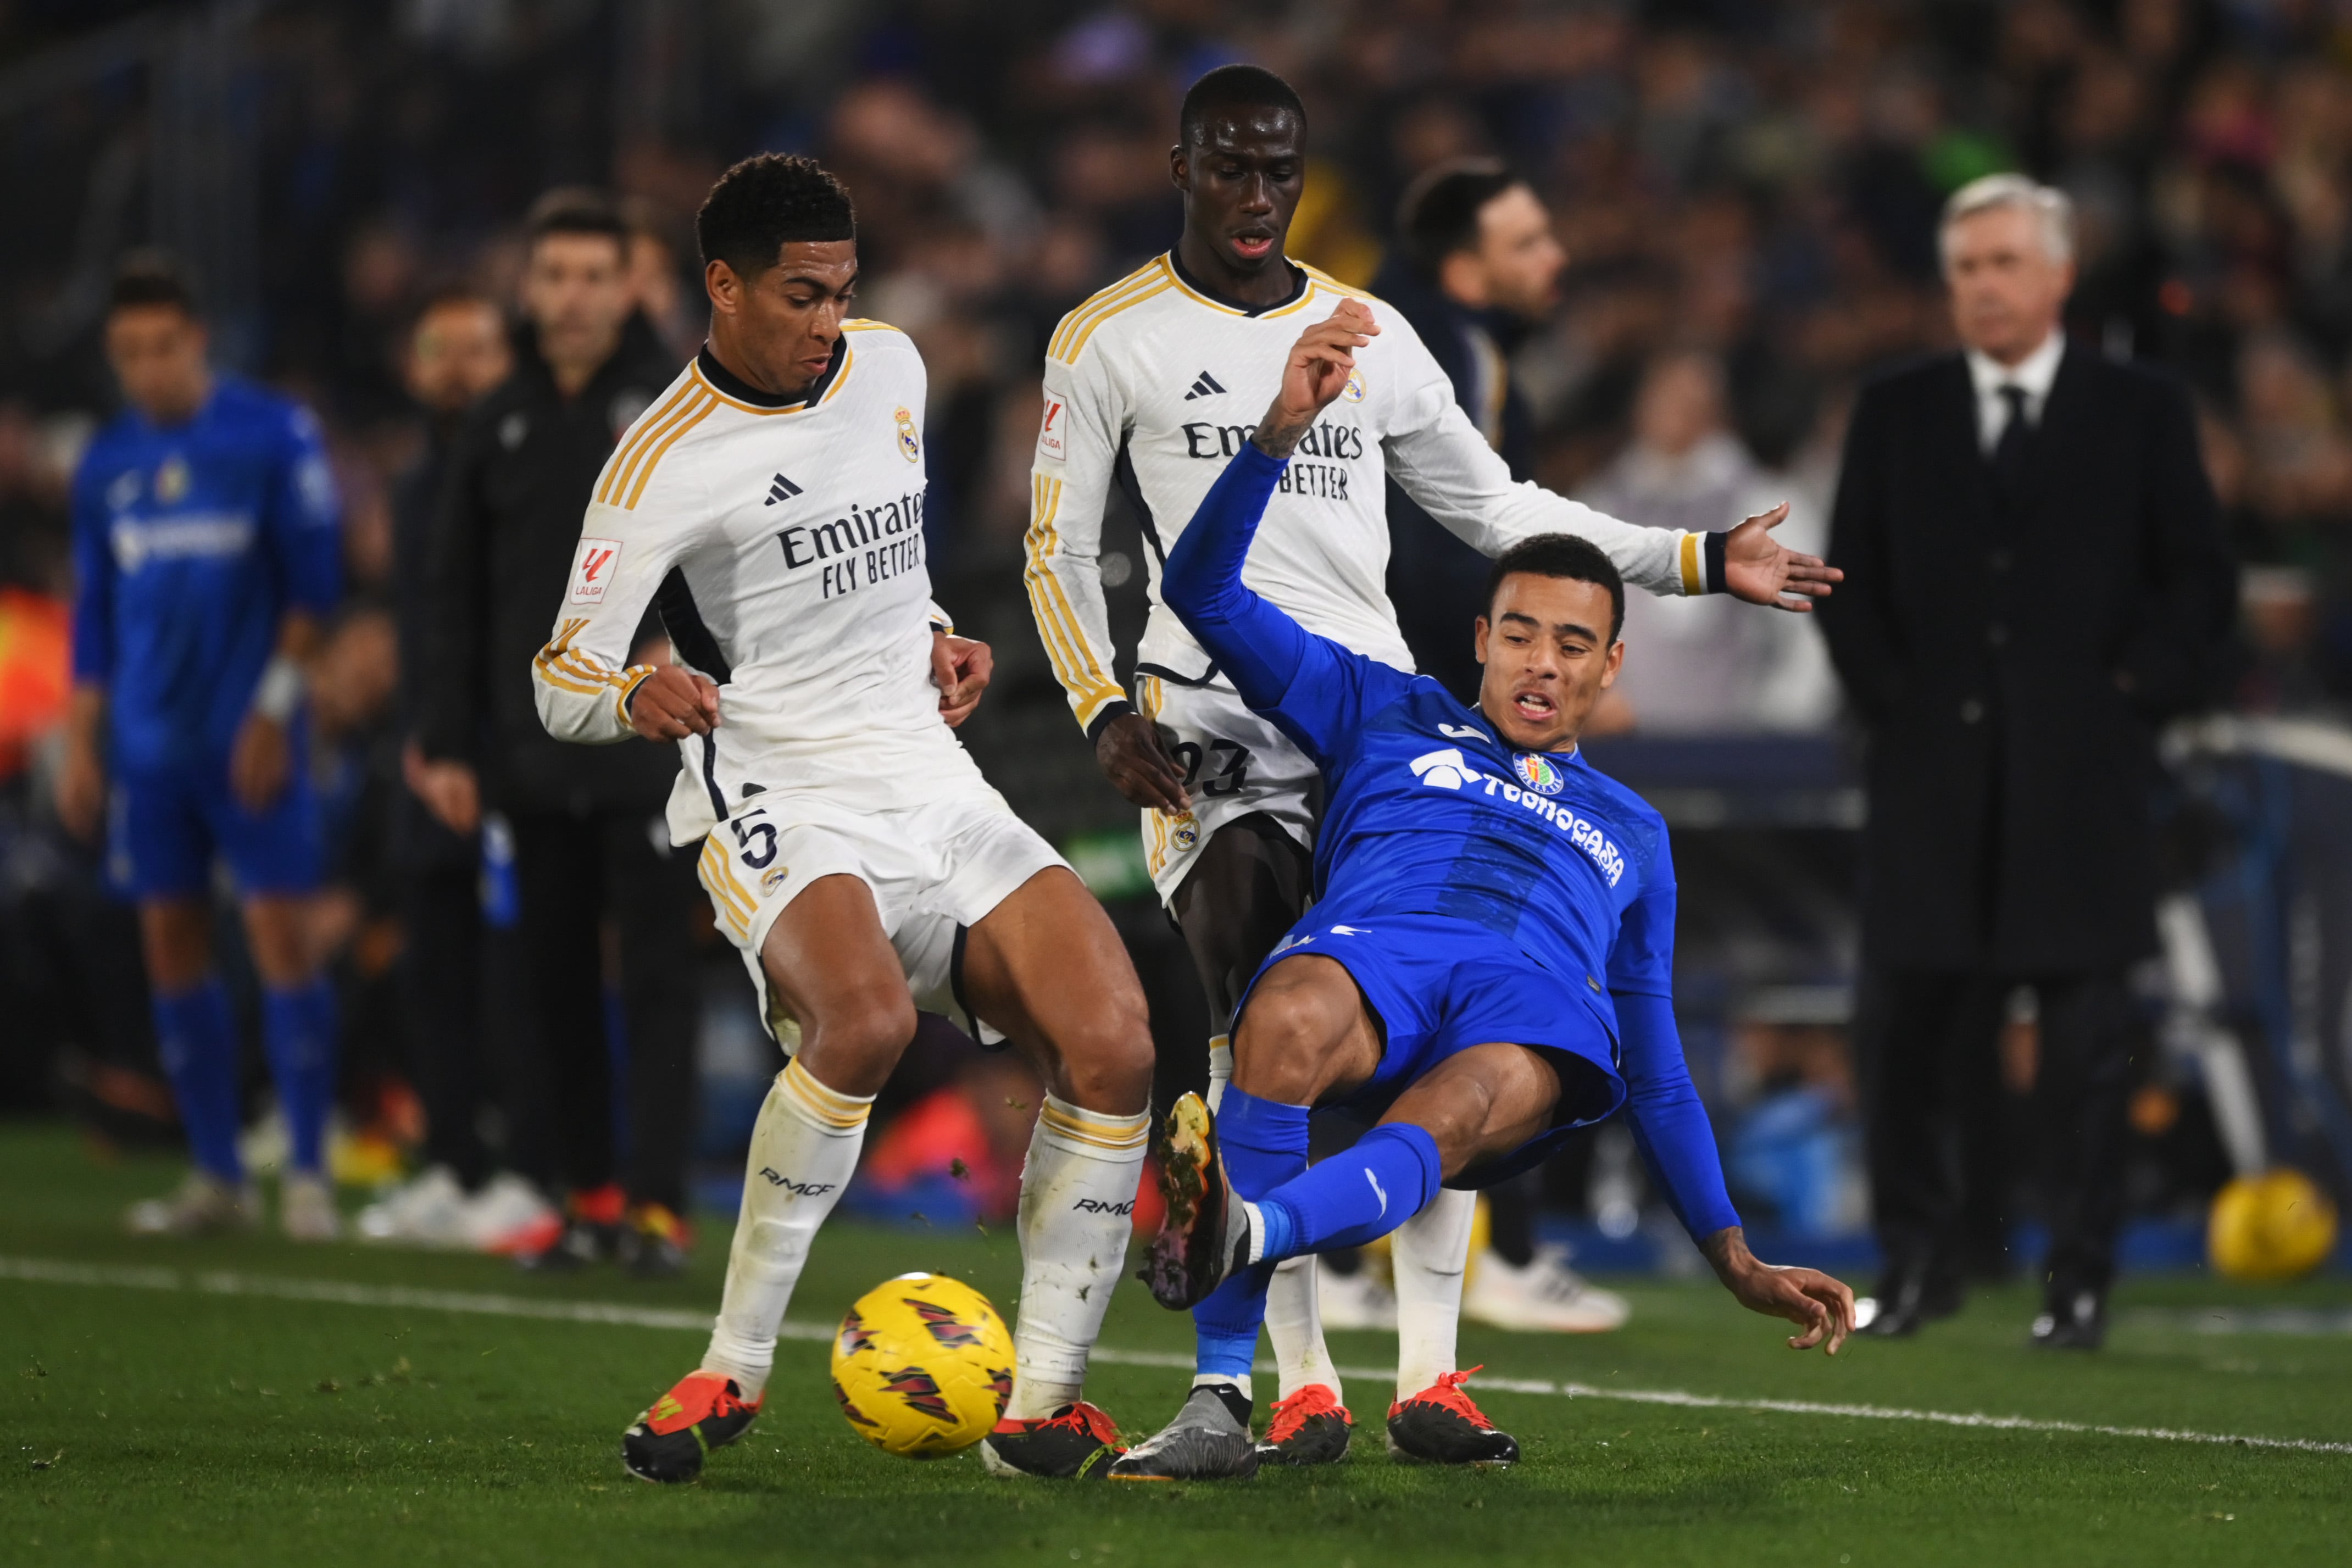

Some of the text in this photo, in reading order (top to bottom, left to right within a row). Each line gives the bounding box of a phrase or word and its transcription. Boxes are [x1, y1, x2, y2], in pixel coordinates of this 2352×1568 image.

[1181, 419, 1363, 460] Emates
[1280, 464, 1348, 501] BETTER
[776, 488, 926, 570] Emirate
[824, 533, 920, 599] FLY BETTER
[575, 586, 602, 596] LALIGA
[731, 808, 777, 869] 5
[759, 1166, 836, 1197] RMCF
